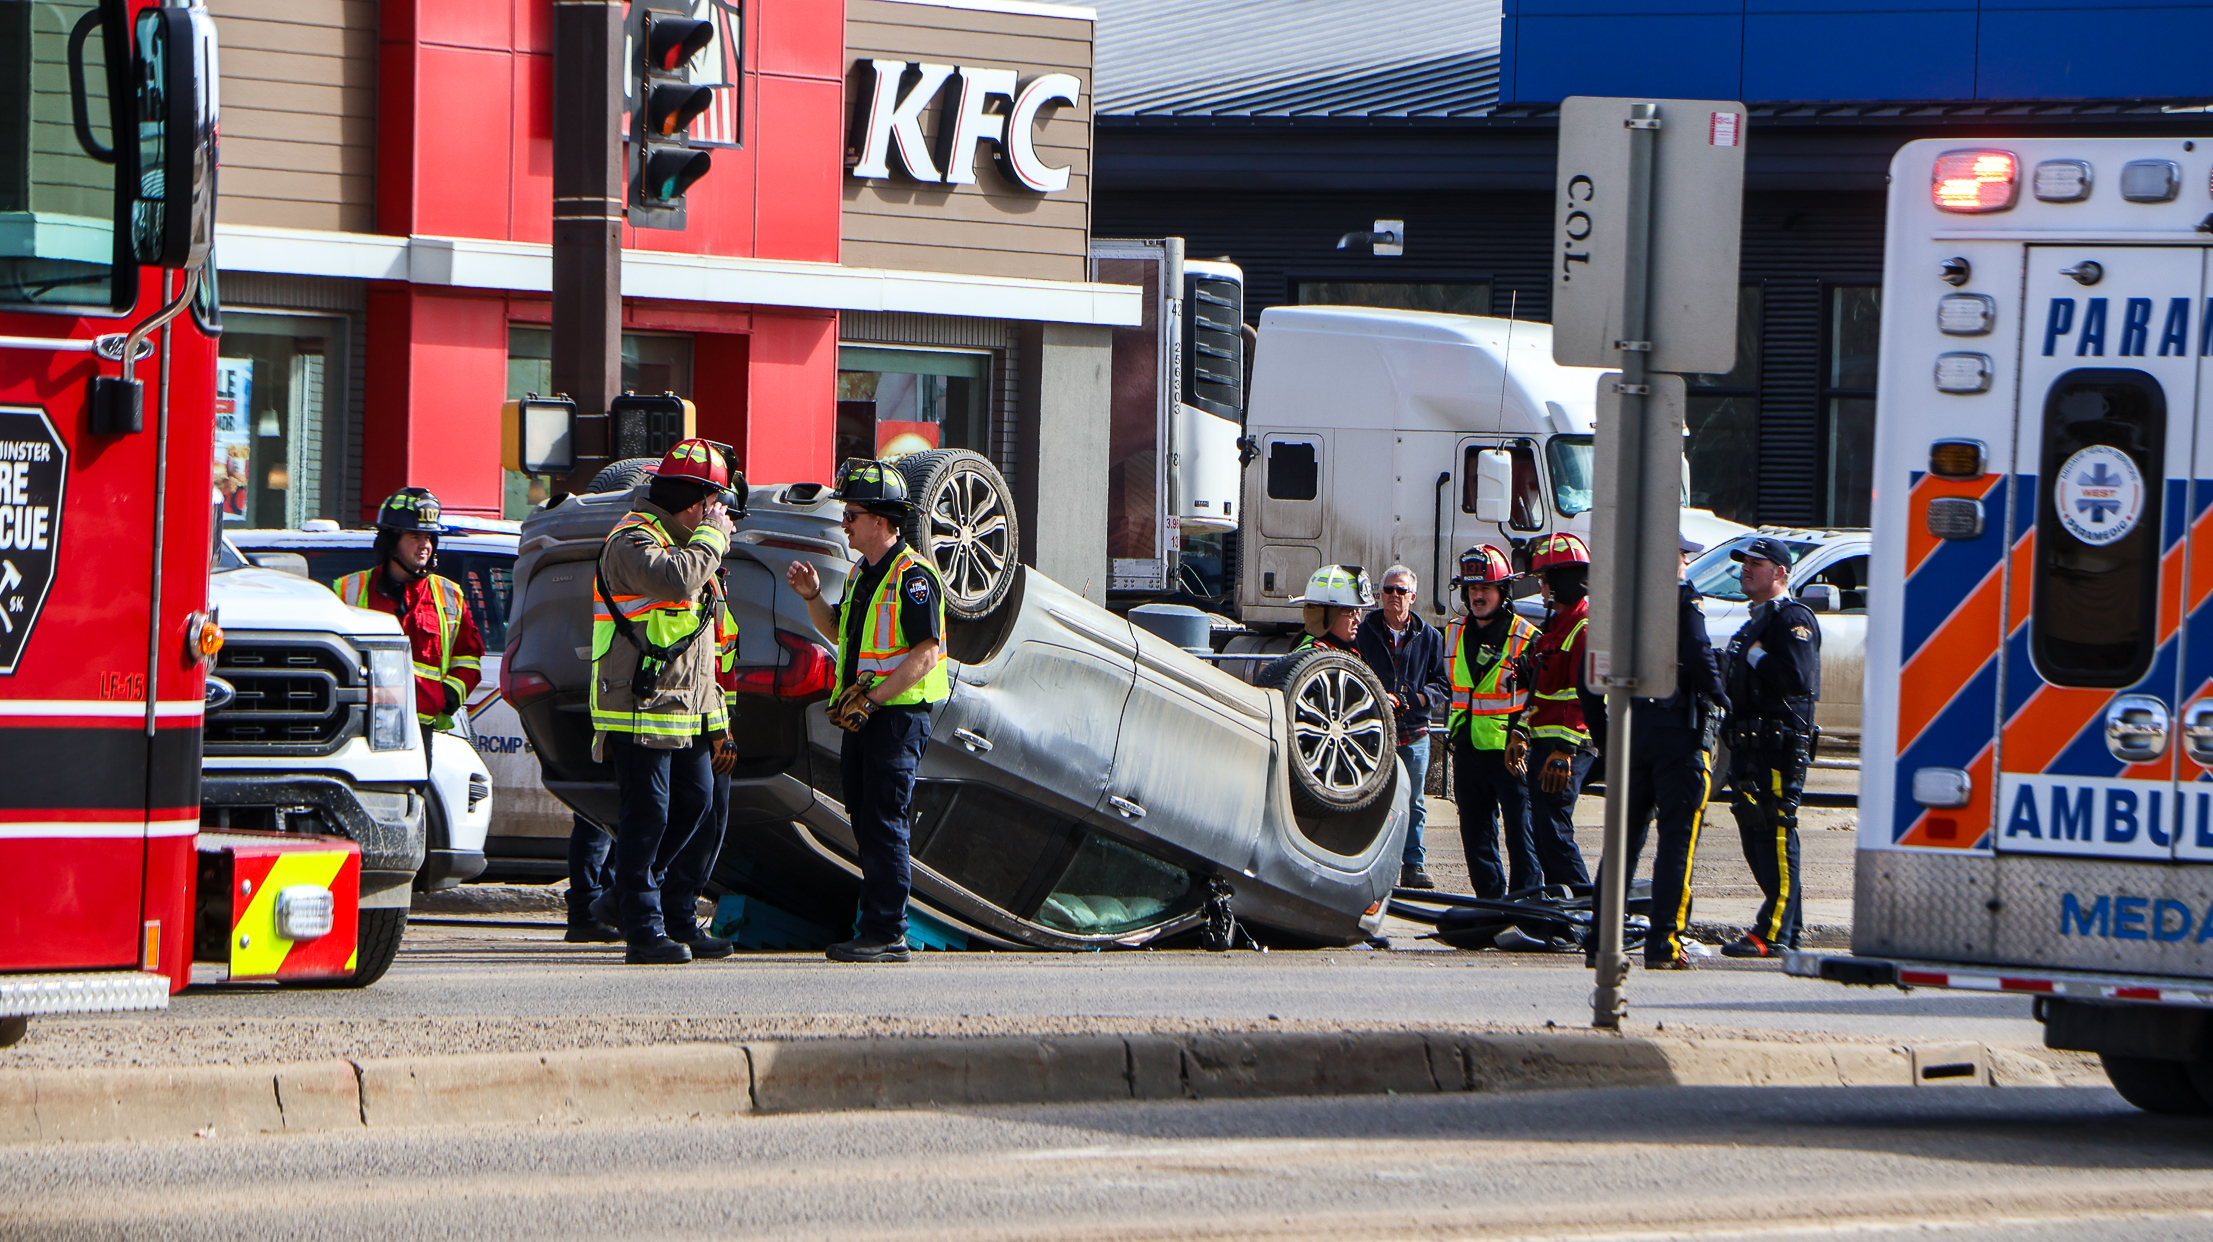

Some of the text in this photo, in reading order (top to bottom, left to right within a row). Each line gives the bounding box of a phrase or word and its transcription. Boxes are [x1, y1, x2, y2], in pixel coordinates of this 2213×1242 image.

[853, 58, 1082, 192] KFC
[1563, 174, 1594, 282] C.O.L.
[2081, 489, 2117, 497] WEST
[0, 505, 49, 551] CUE
[1463, 562, 1484, 575] 131
[9, 596, 24, 612] SK
[100, 673, 144, 700] LF-15
[478, 734, 523, 753] RCMP
